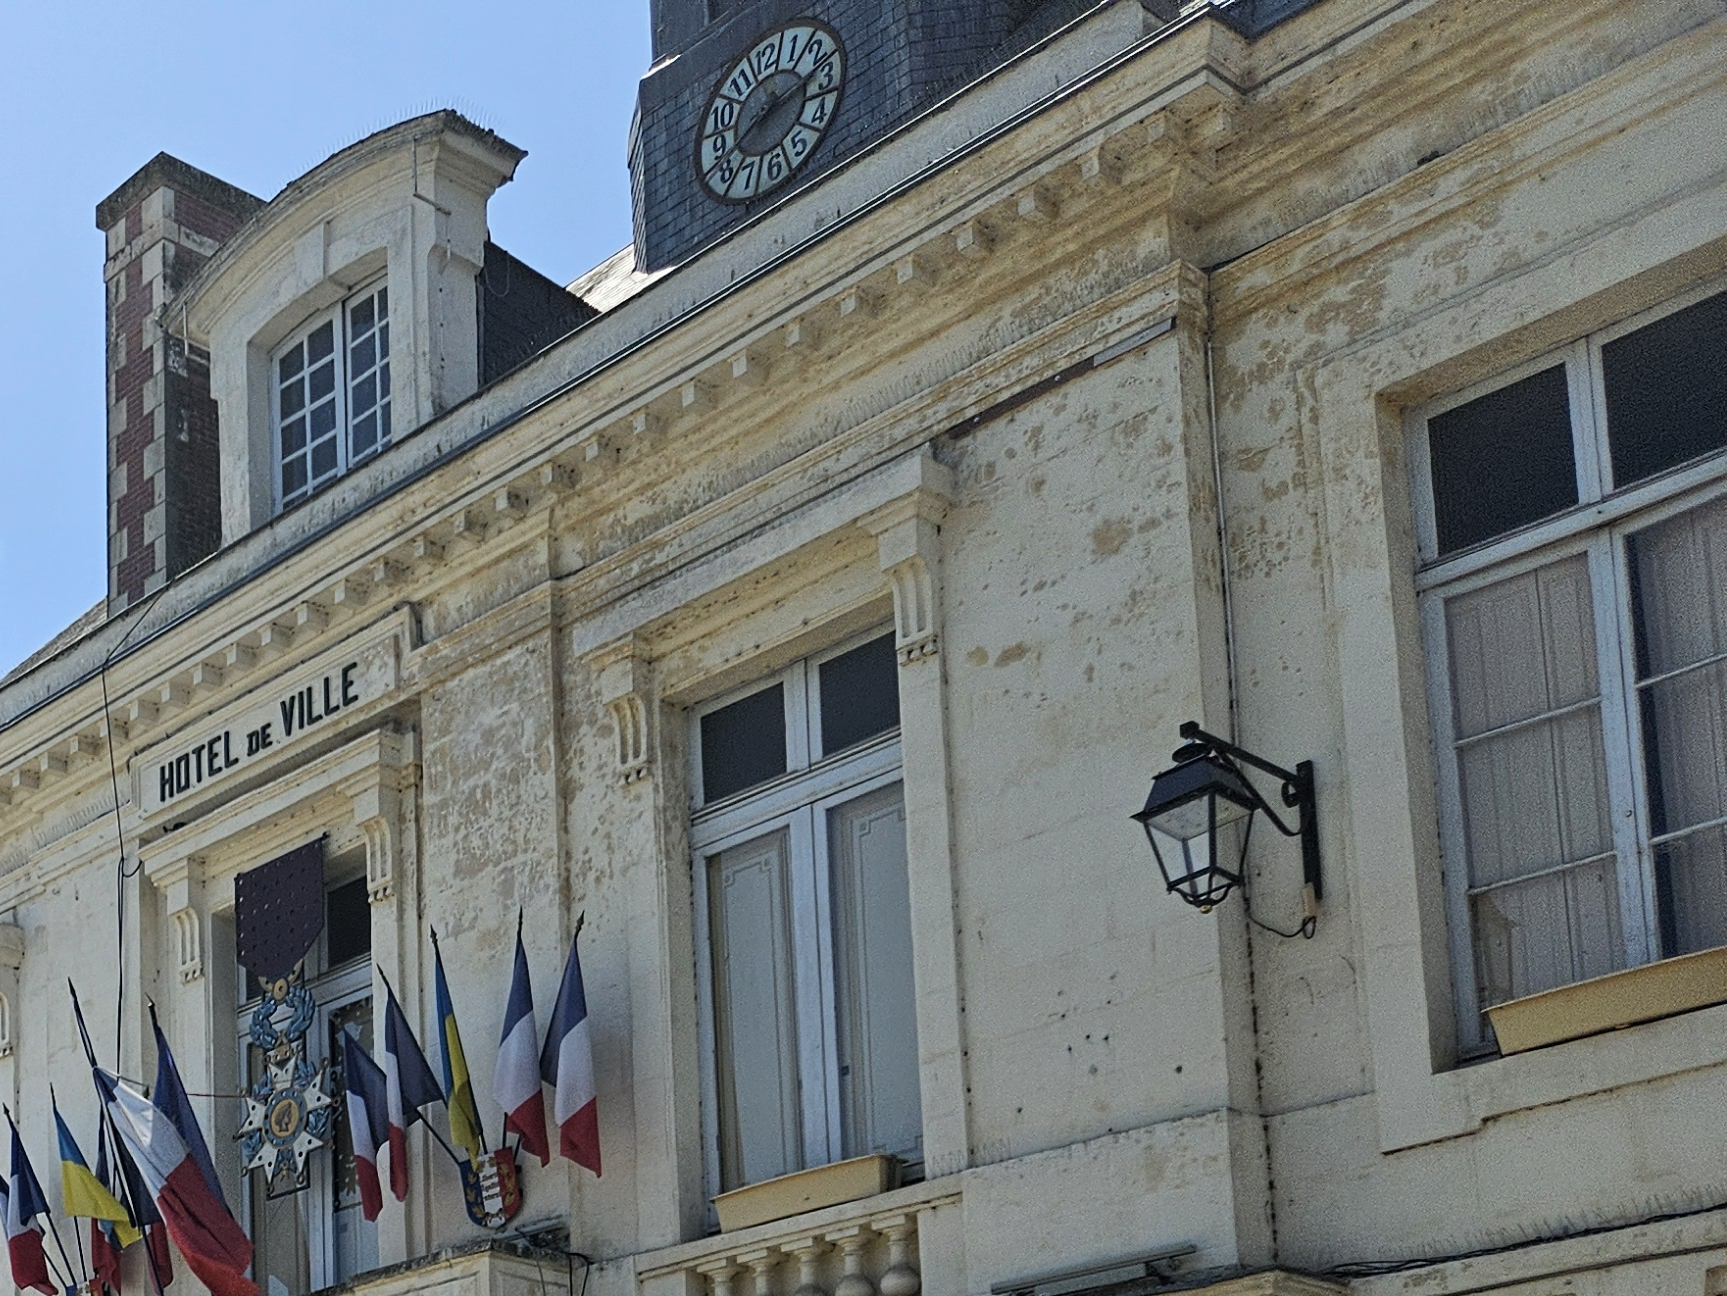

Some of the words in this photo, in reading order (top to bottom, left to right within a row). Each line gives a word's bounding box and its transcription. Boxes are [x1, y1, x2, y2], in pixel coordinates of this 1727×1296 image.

[755, 43, 776, 75] 12
[787, 34, 799, 64] 1
[808, 38, 828, 67] 2
[729, 68, 753, 98] 11
[818, 61, 834, 91] 3
[711, 102, 734, 133] 10
[811, 97, 826, 124] 4
[712, 134, 727, 161] 9
[791, 131, 808, 157] 5
[719, 157, 734, 184] 8
[741, 162, 756, 191] 7
[767, 152, 783, 181] 6
[159, 730, 239, 802] HOTEL
[246, 723, 273, 757] DE
[279, 661, 359, 737] VILLE
